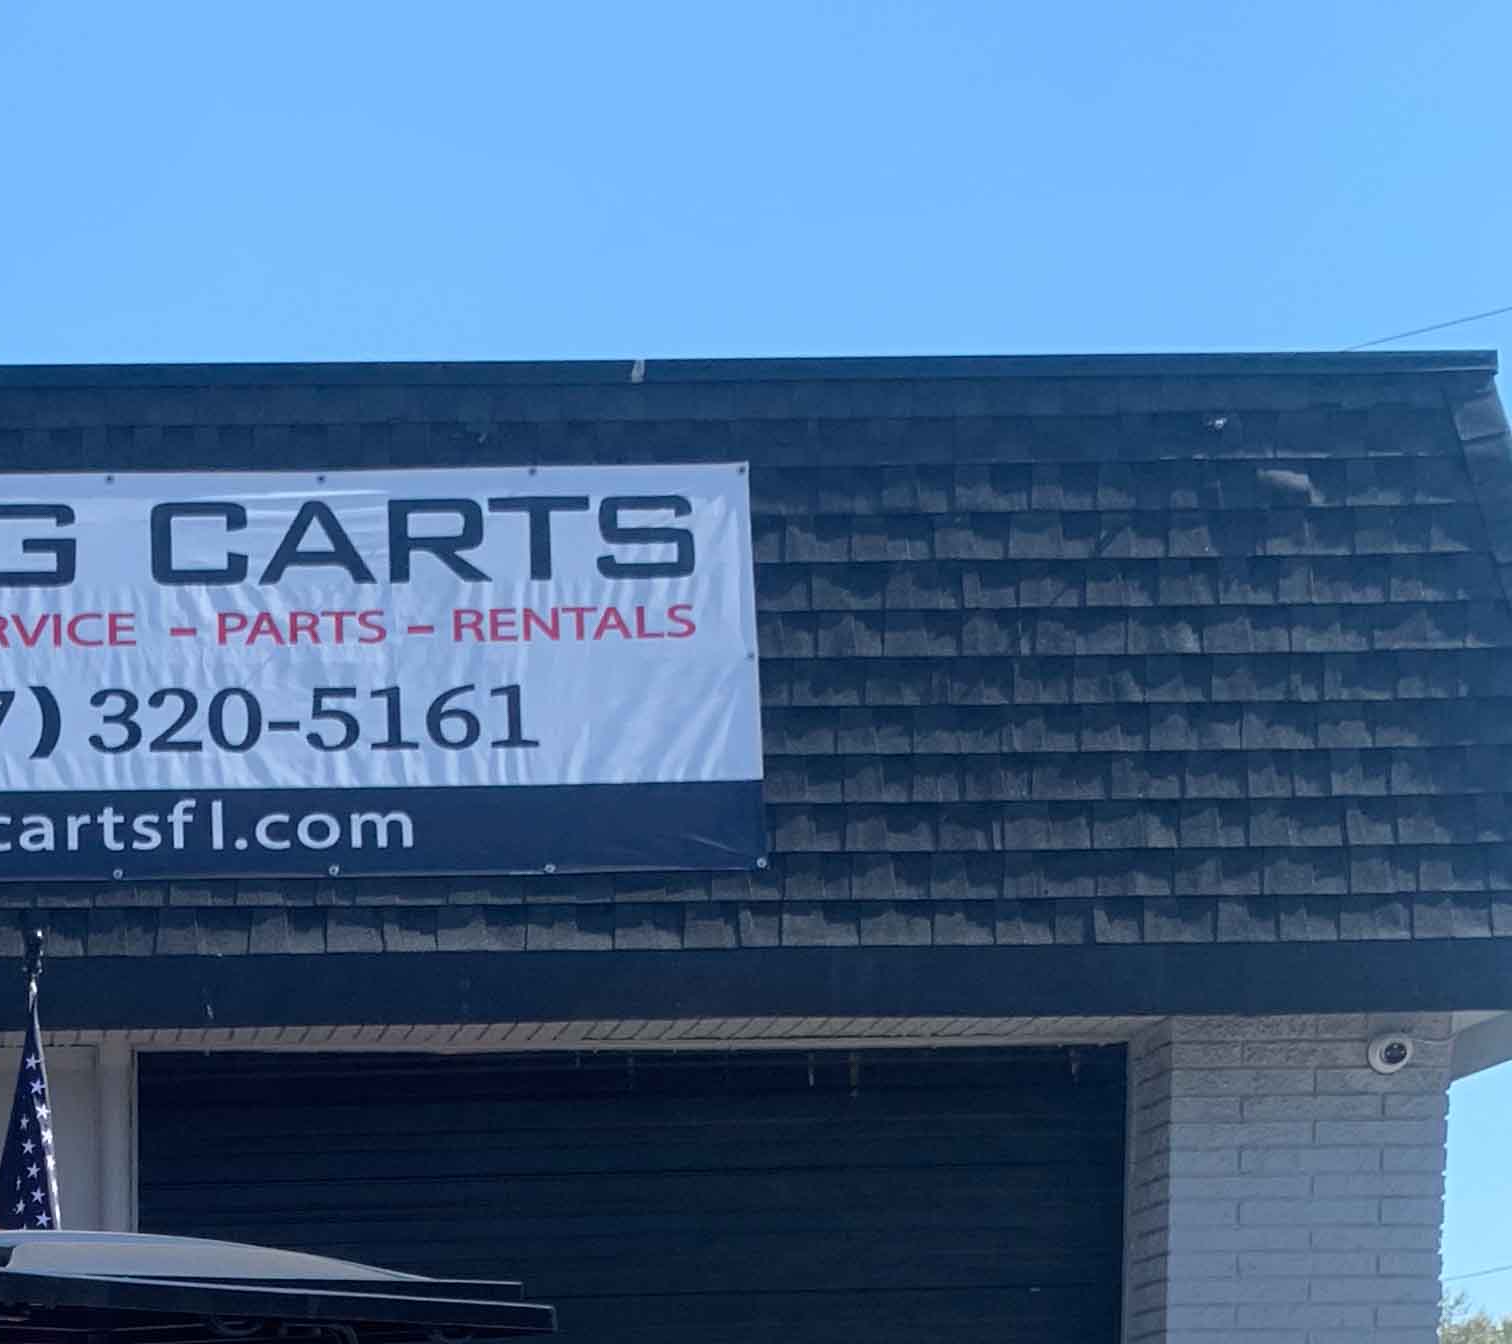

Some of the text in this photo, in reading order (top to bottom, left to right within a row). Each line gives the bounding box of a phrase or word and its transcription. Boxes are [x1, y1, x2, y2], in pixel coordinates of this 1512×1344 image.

[149, 493, 697, 587] CARTS
[216, 610, 388, 645] PARTS
[452, 604, 697, 642] RENTALS
[88, 683, 540, 755] 320-5161
